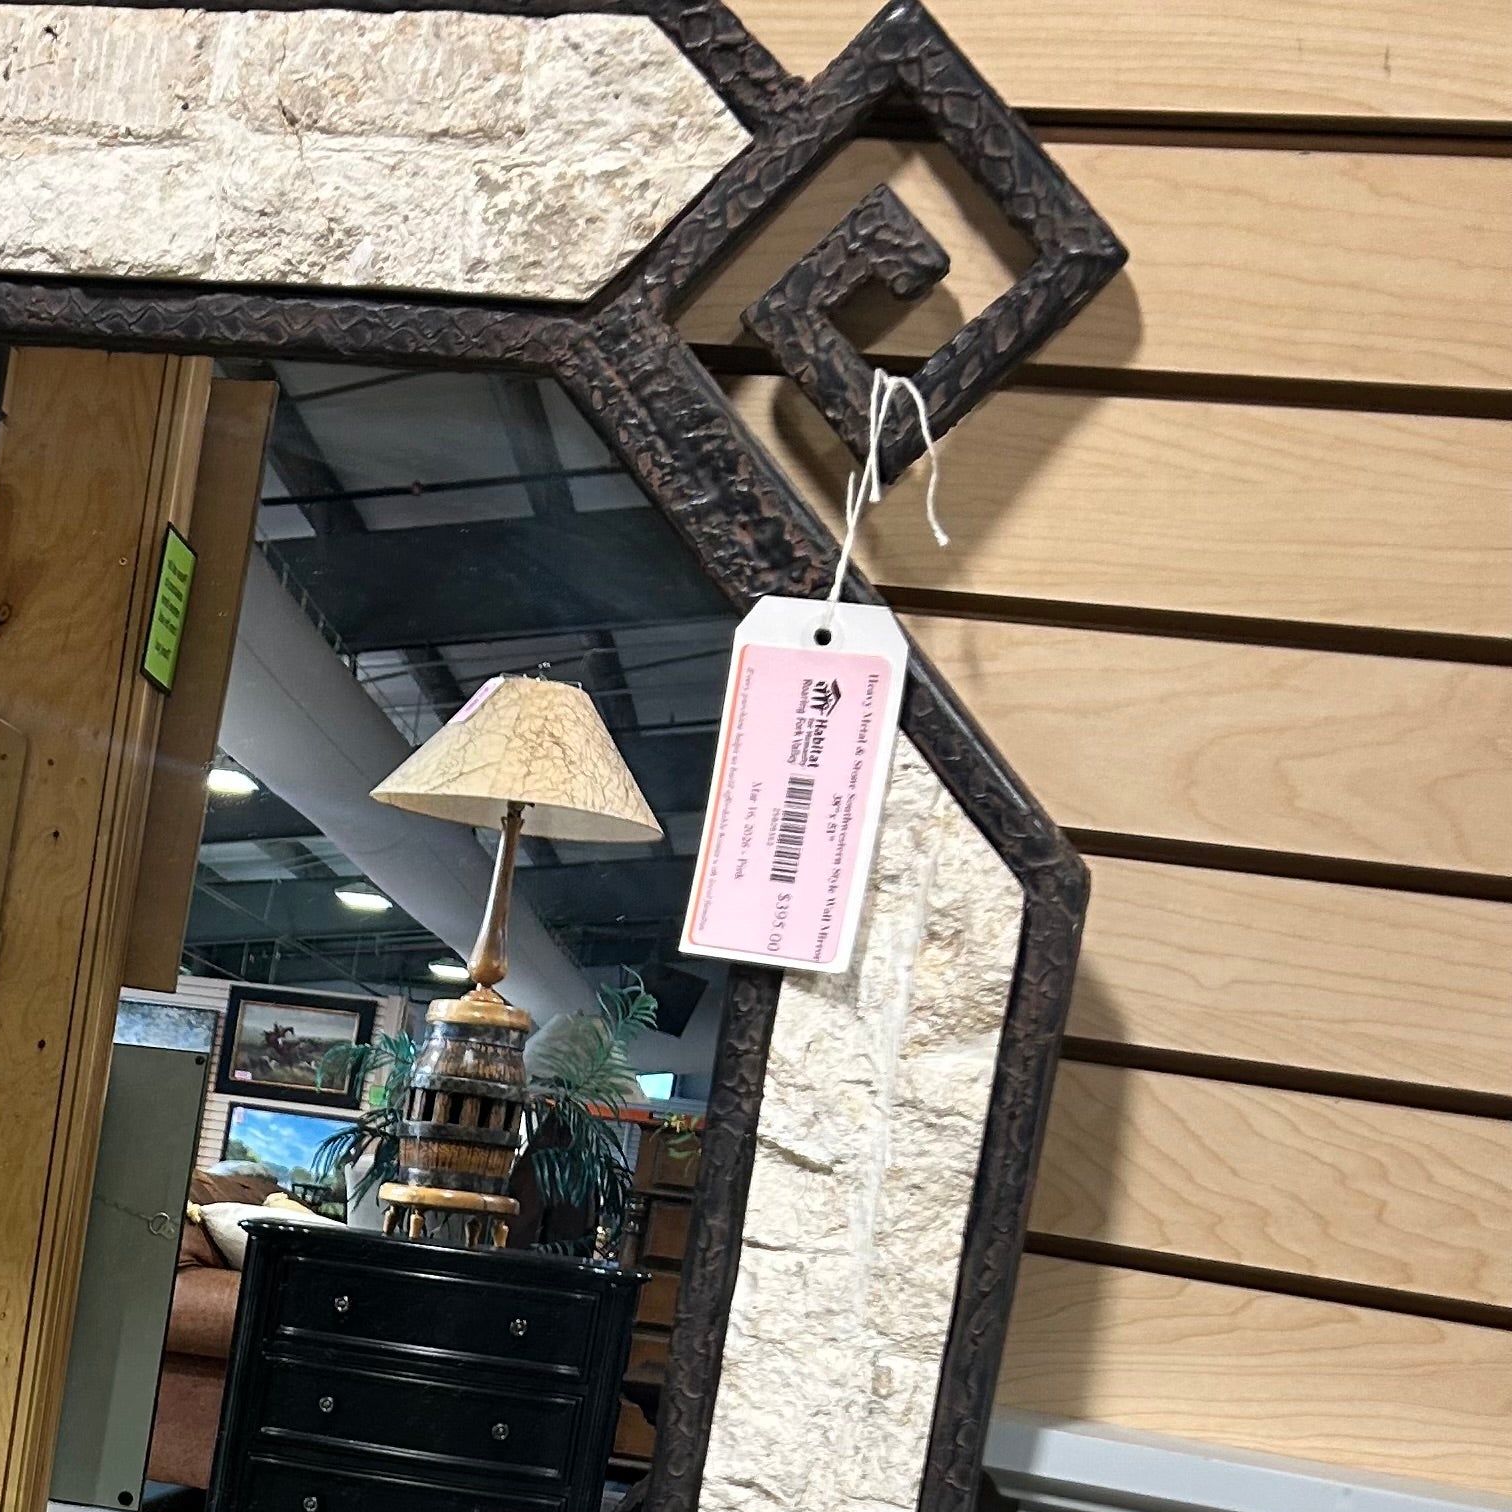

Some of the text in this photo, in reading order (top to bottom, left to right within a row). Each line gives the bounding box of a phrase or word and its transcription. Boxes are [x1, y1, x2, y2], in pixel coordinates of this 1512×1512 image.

[786, 678, 813, 764] Roaring Fork Valley
[807, 718, 828, 768] Habitat
[748, 781, 763, 803] Mar
[812, 674, 879, 961] Heavy Metal & Stone Southwestern Style Wall Mirror
[733, 857, 747, 880] Pink
[766, 892, 792, 952] $395.00
